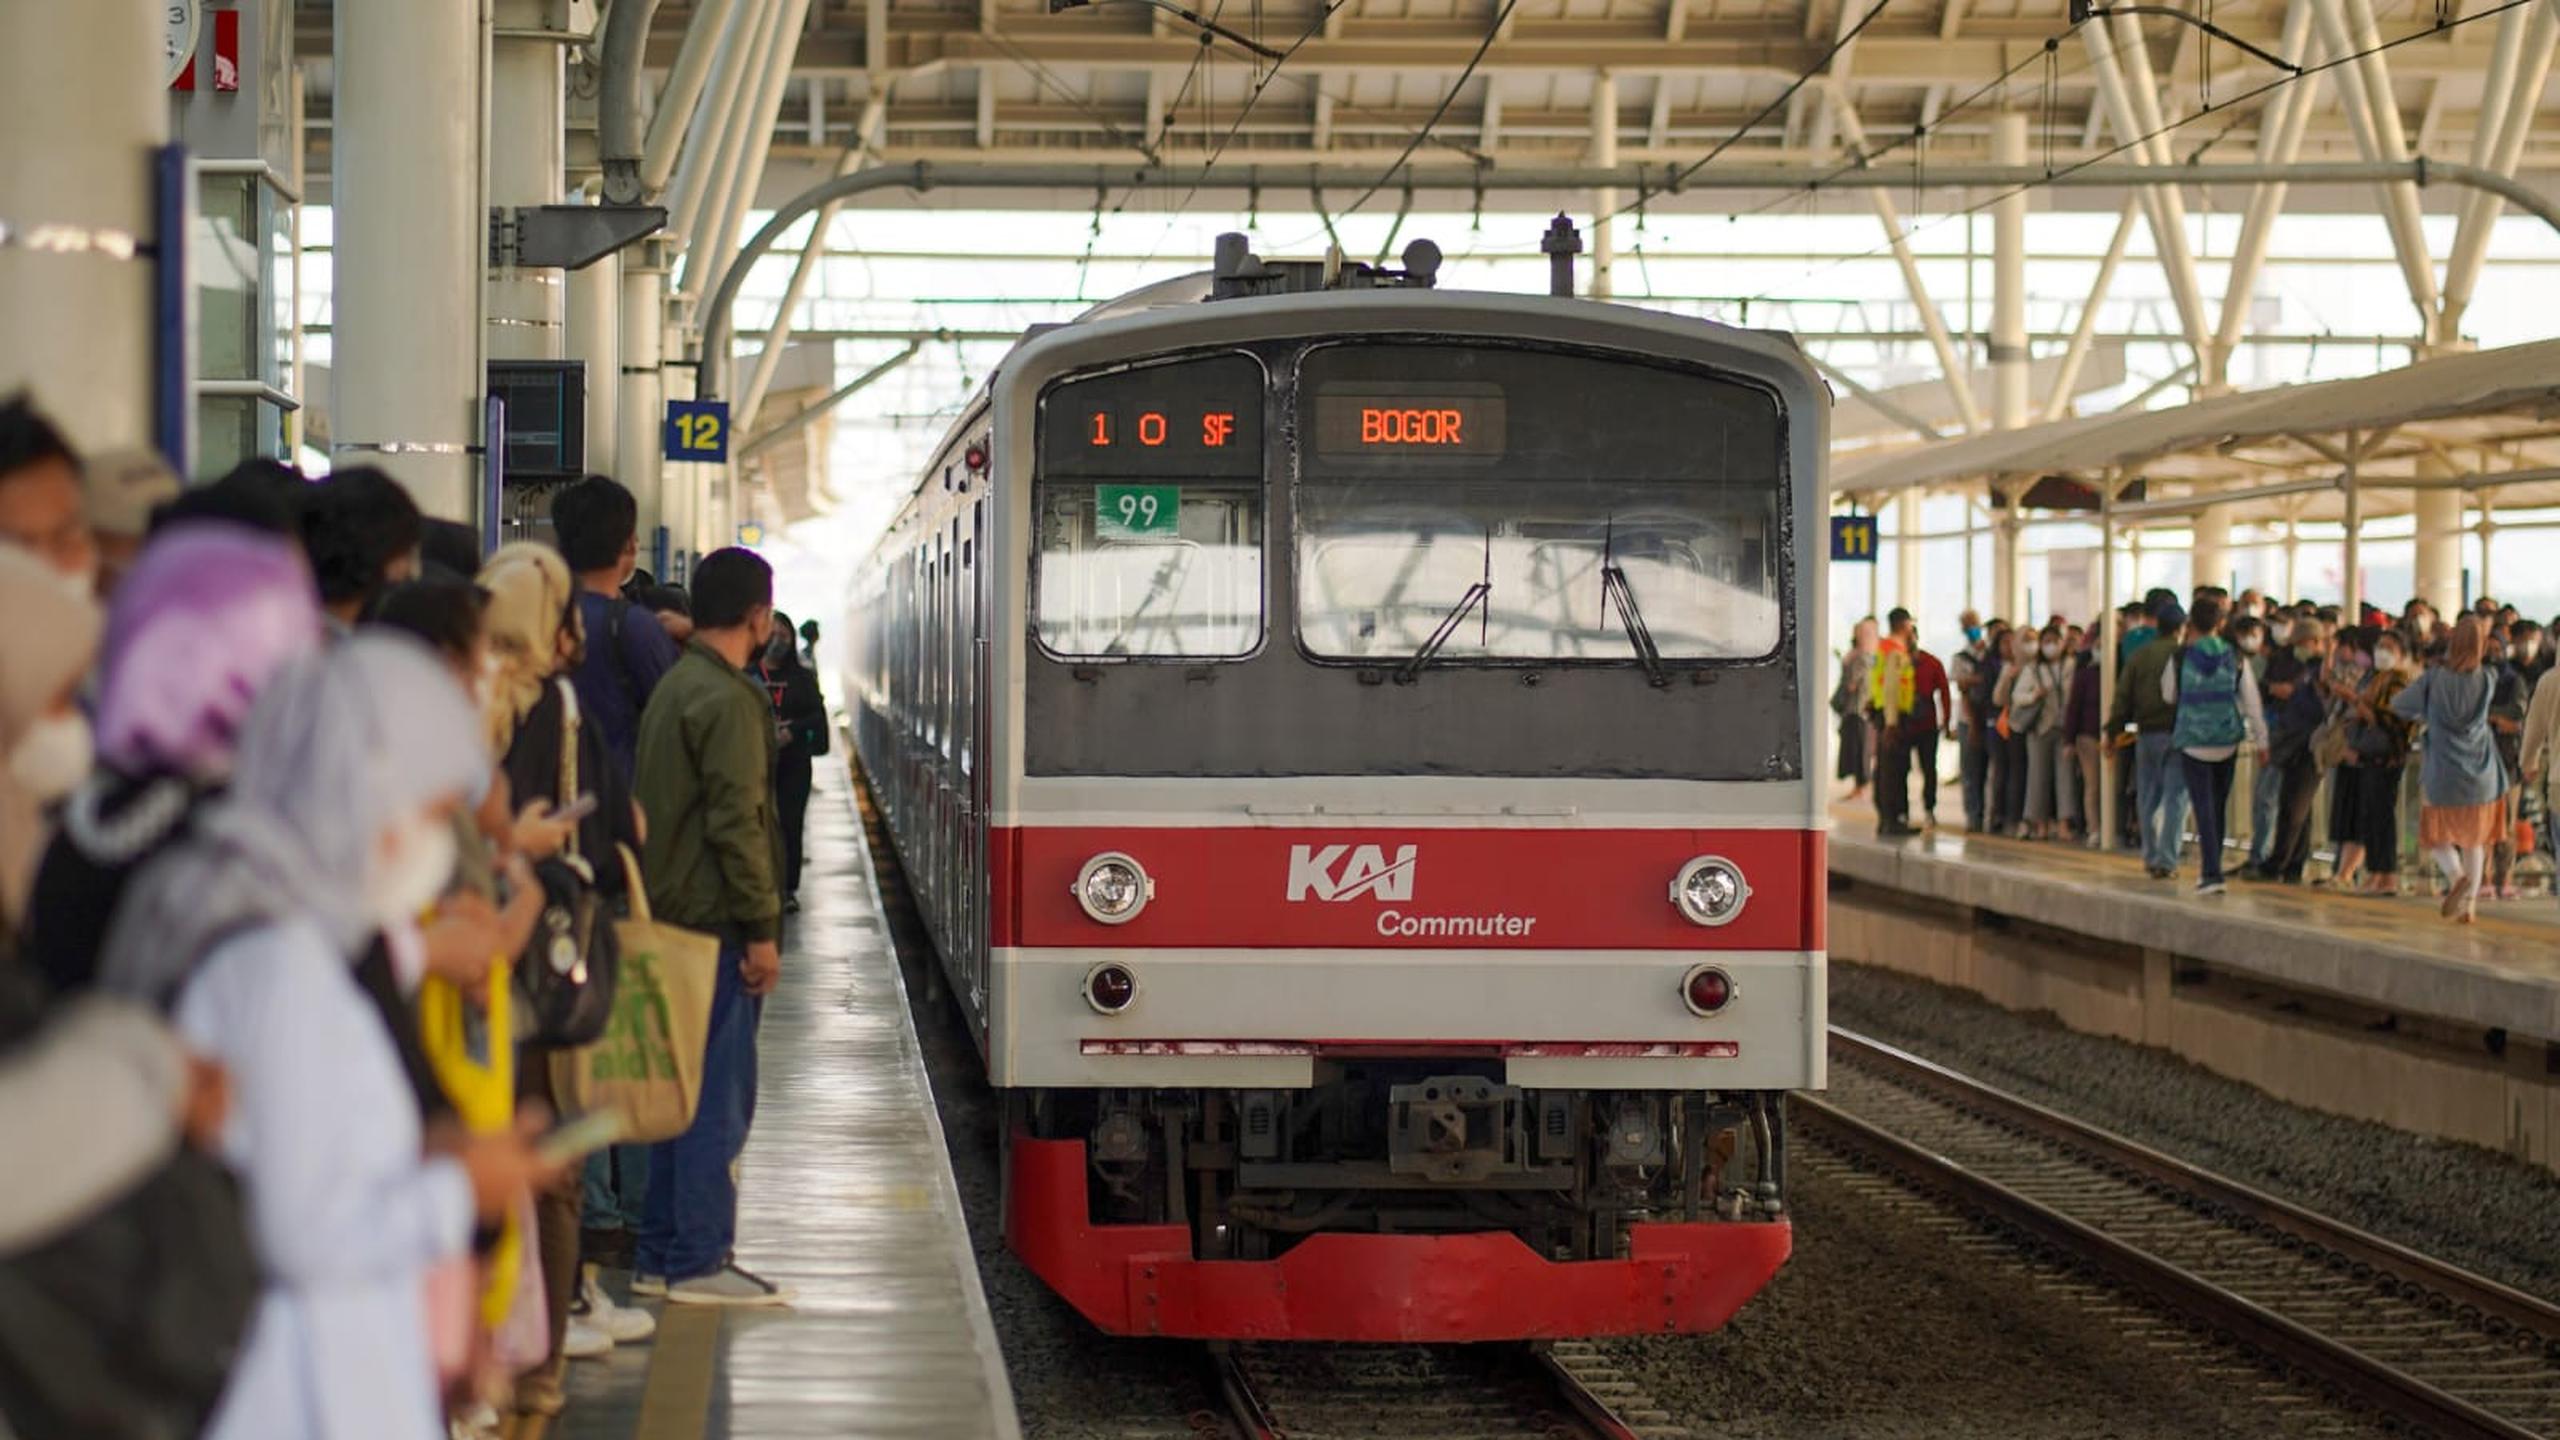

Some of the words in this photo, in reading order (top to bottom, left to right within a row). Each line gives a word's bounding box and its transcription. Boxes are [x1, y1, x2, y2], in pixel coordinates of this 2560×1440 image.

[675, 413, 719, 449] 12
[1203, 413, 1234, 446] SF
[1362, 409, 1462, 444] BOGOR
[1119, 495, 1158, 526] 99
[1841, 525, 1869, 554] 11
[1287, 844, 1418, 901] KAI
[1376, 910, 1536, 936] Commuter
